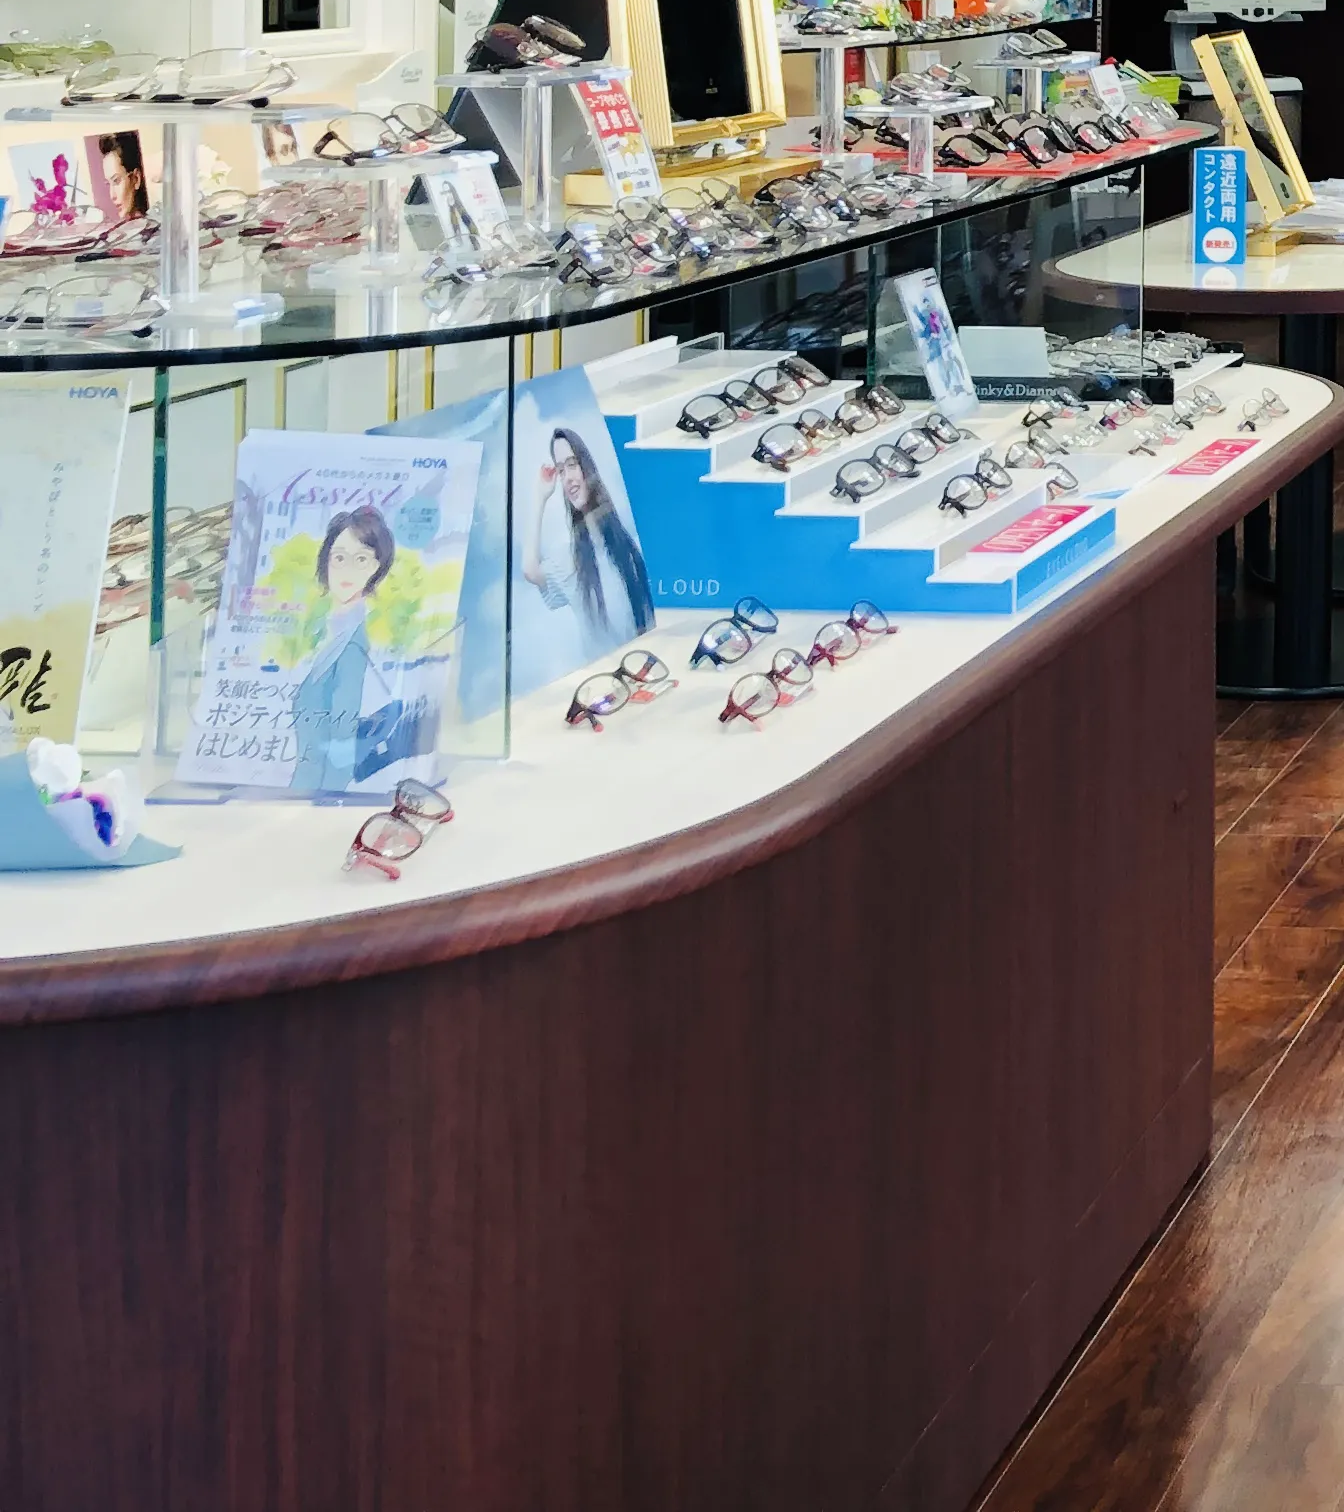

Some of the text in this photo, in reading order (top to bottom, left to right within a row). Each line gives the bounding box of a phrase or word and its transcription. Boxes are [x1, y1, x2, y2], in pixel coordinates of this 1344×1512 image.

[1203, 154, 1216, 223] コンタクト
[1220, 153, 1237, 223] 遠近両用
[69, 387, 119, 399] HOYA
[412, 458, 448, 469] HOYA
[648, 578, 720, 596] LOUD
[215, 678, 302, 702] 笑顔をつくる
